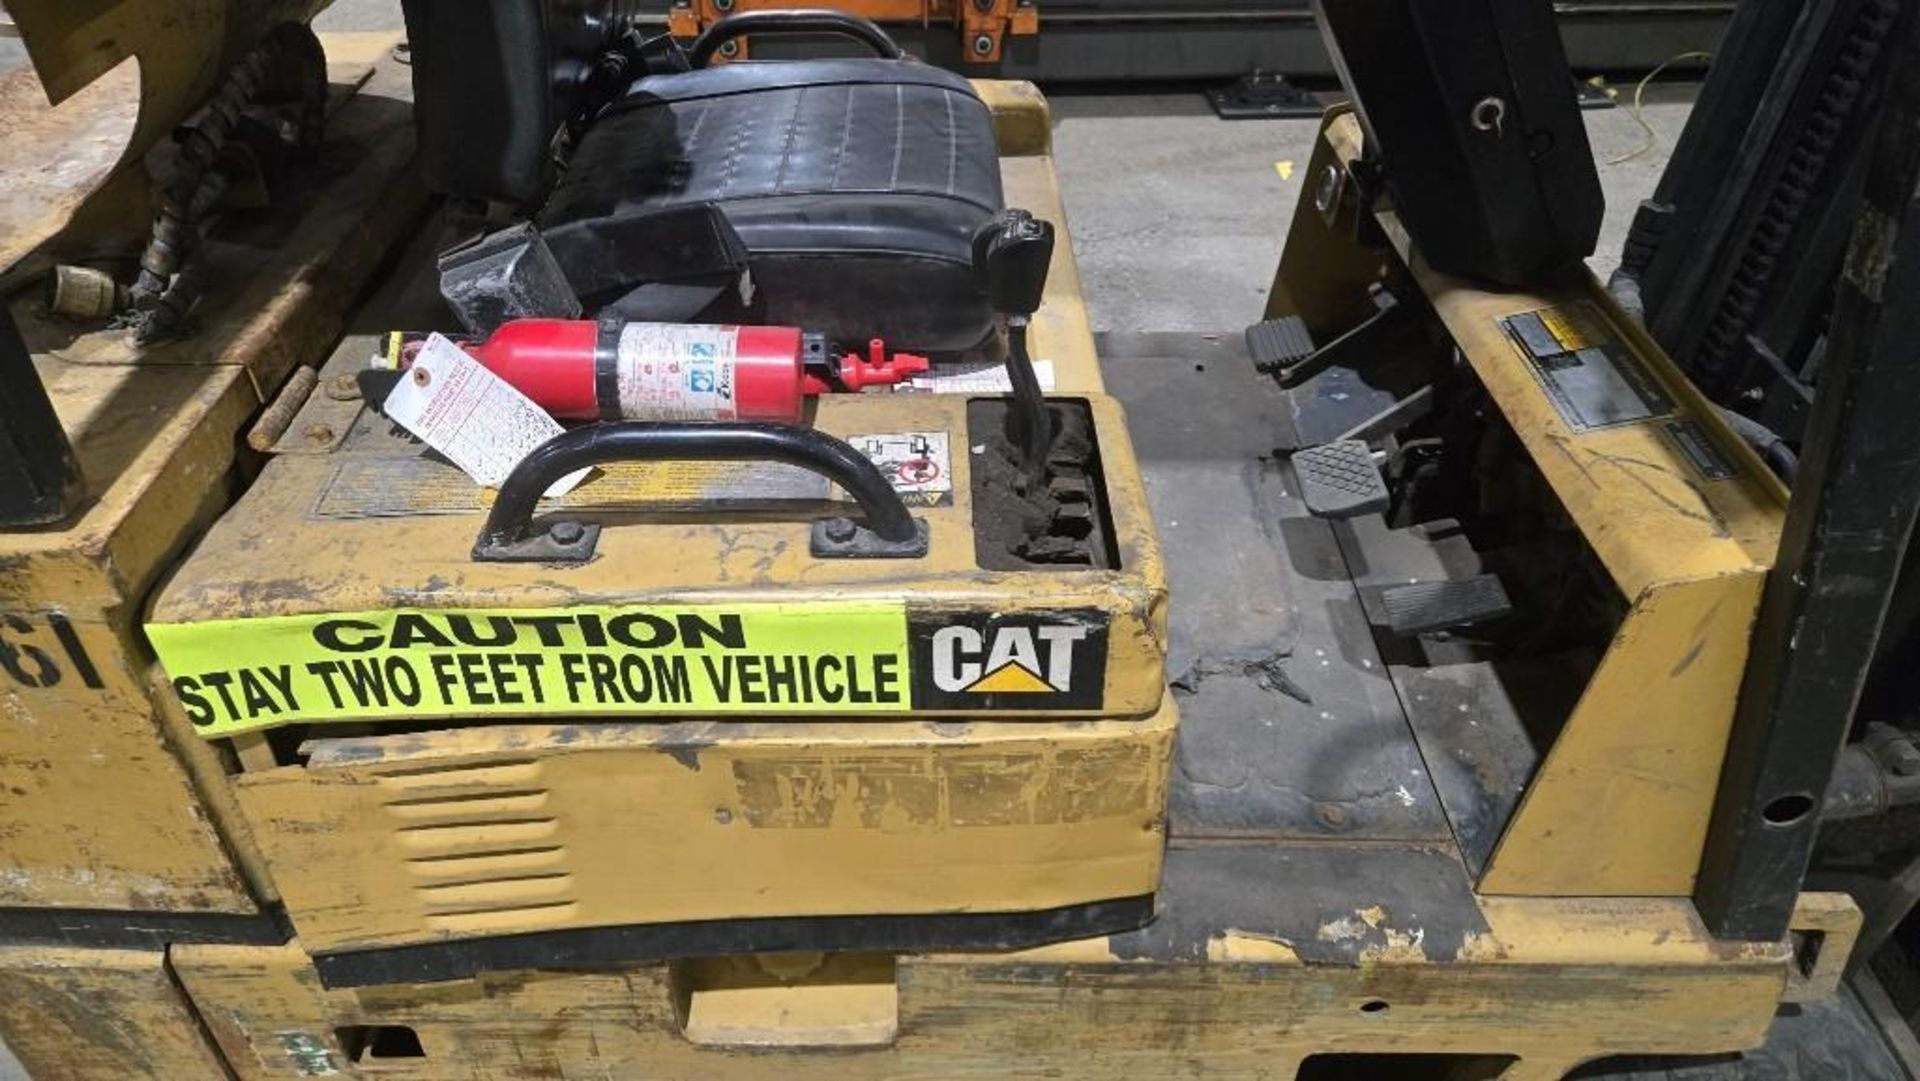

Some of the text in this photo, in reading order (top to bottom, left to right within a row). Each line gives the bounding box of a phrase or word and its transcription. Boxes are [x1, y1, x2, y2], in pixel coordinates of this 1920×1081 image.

[314, 613, 745, 652] CAUTION
[932, 625, 1087, 693] CAT
[175, 654, 900, 726] STAY TWO FEET FROM VEHICLE
